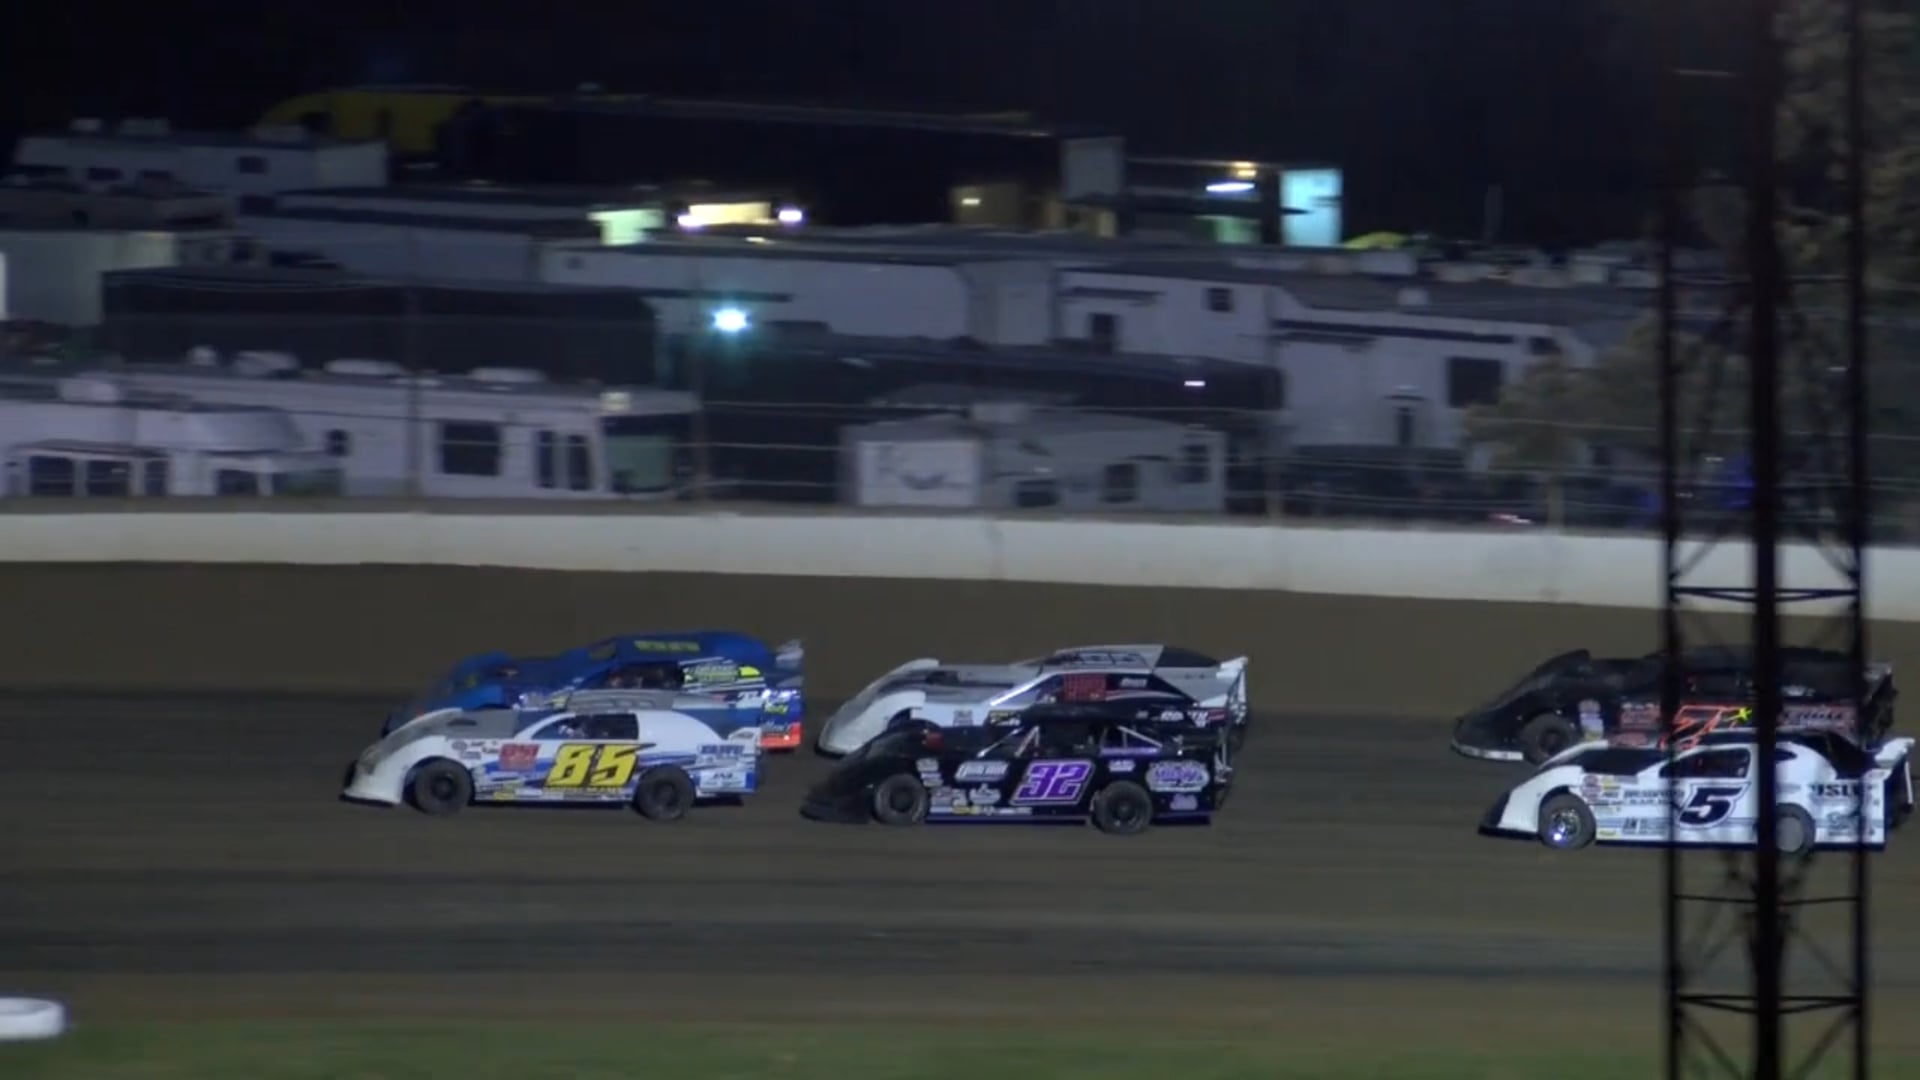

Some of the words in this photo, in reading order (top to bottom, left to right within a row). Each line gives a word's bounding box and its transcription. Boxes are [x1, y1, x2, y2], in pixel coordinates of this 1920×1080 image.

[545, 744, 638, 787] 85
[1013, 761, 1093, 804] 32
[1678, 786, 1744, 826] 5
